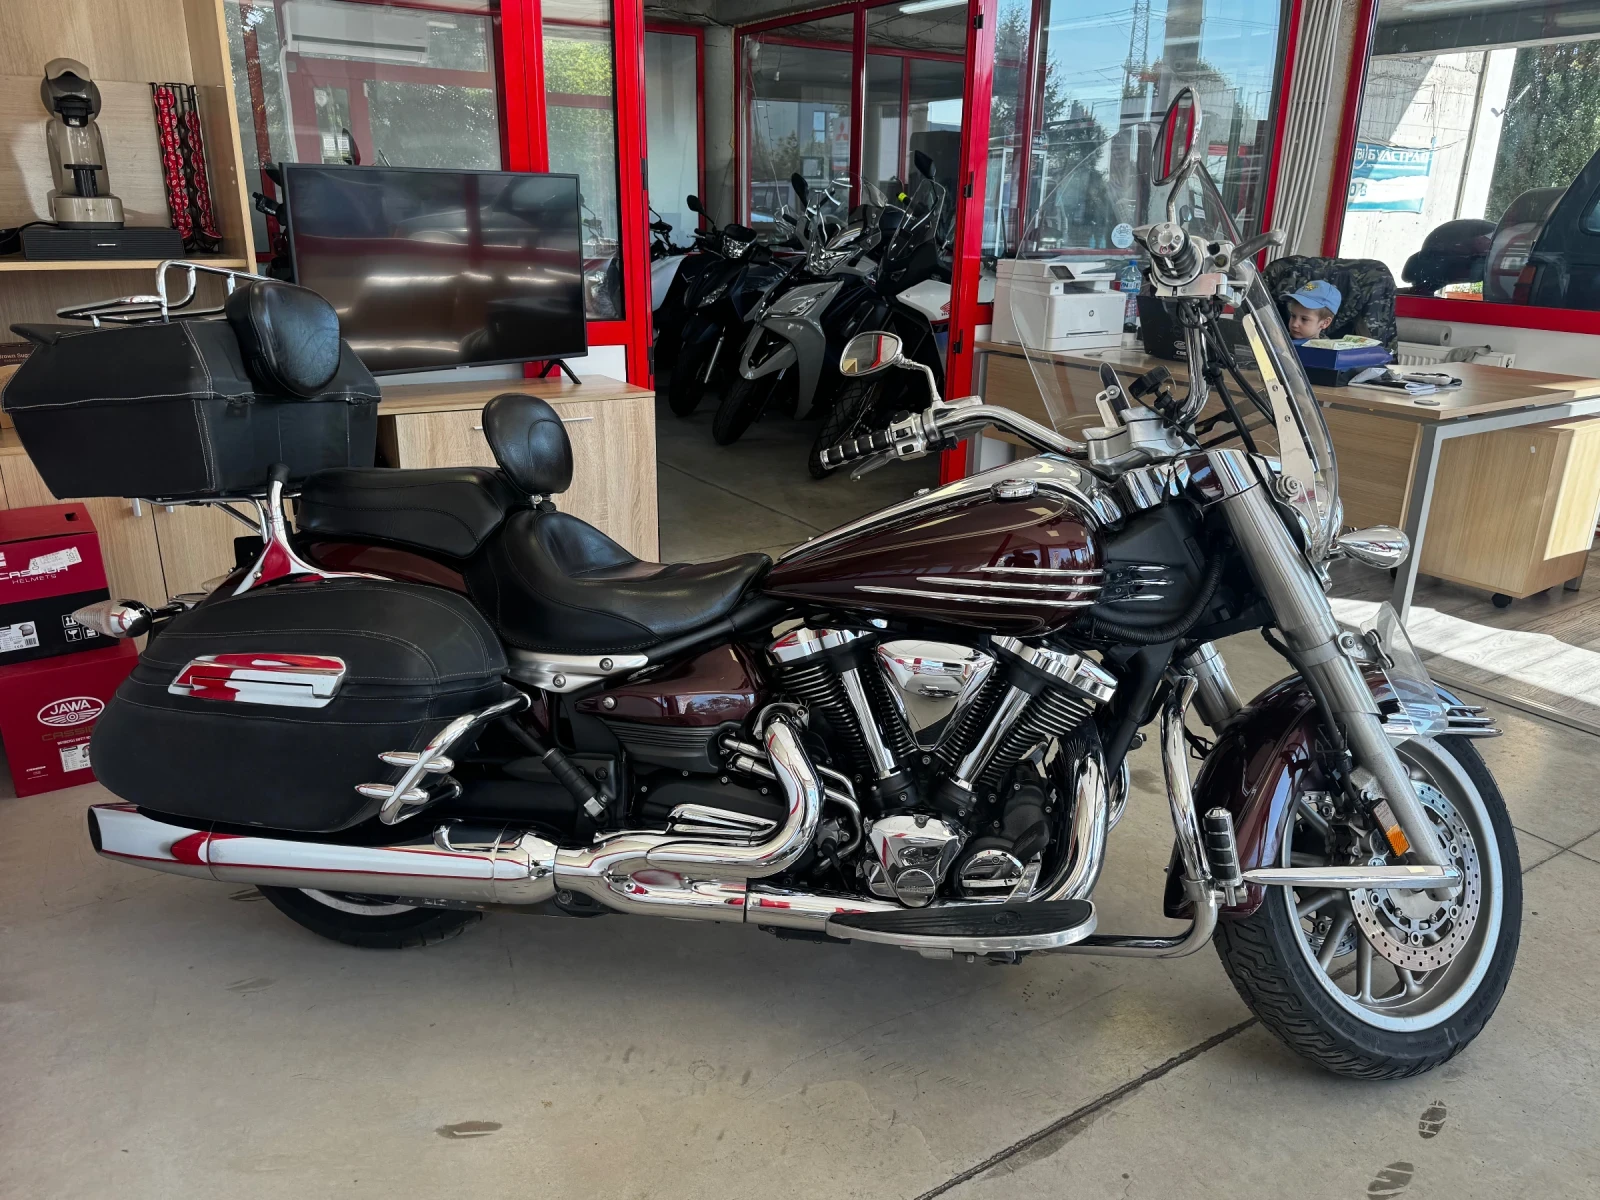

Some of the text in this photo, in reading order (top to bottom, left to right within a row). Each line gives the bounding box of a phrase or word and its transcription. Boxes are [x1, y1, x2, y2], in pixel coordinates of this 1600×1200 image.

[12, 574, 57, 585] HELMETS
[50, 700, 91, 715] JAWA
[1292, 962, 1358, 1036] SHINKO
